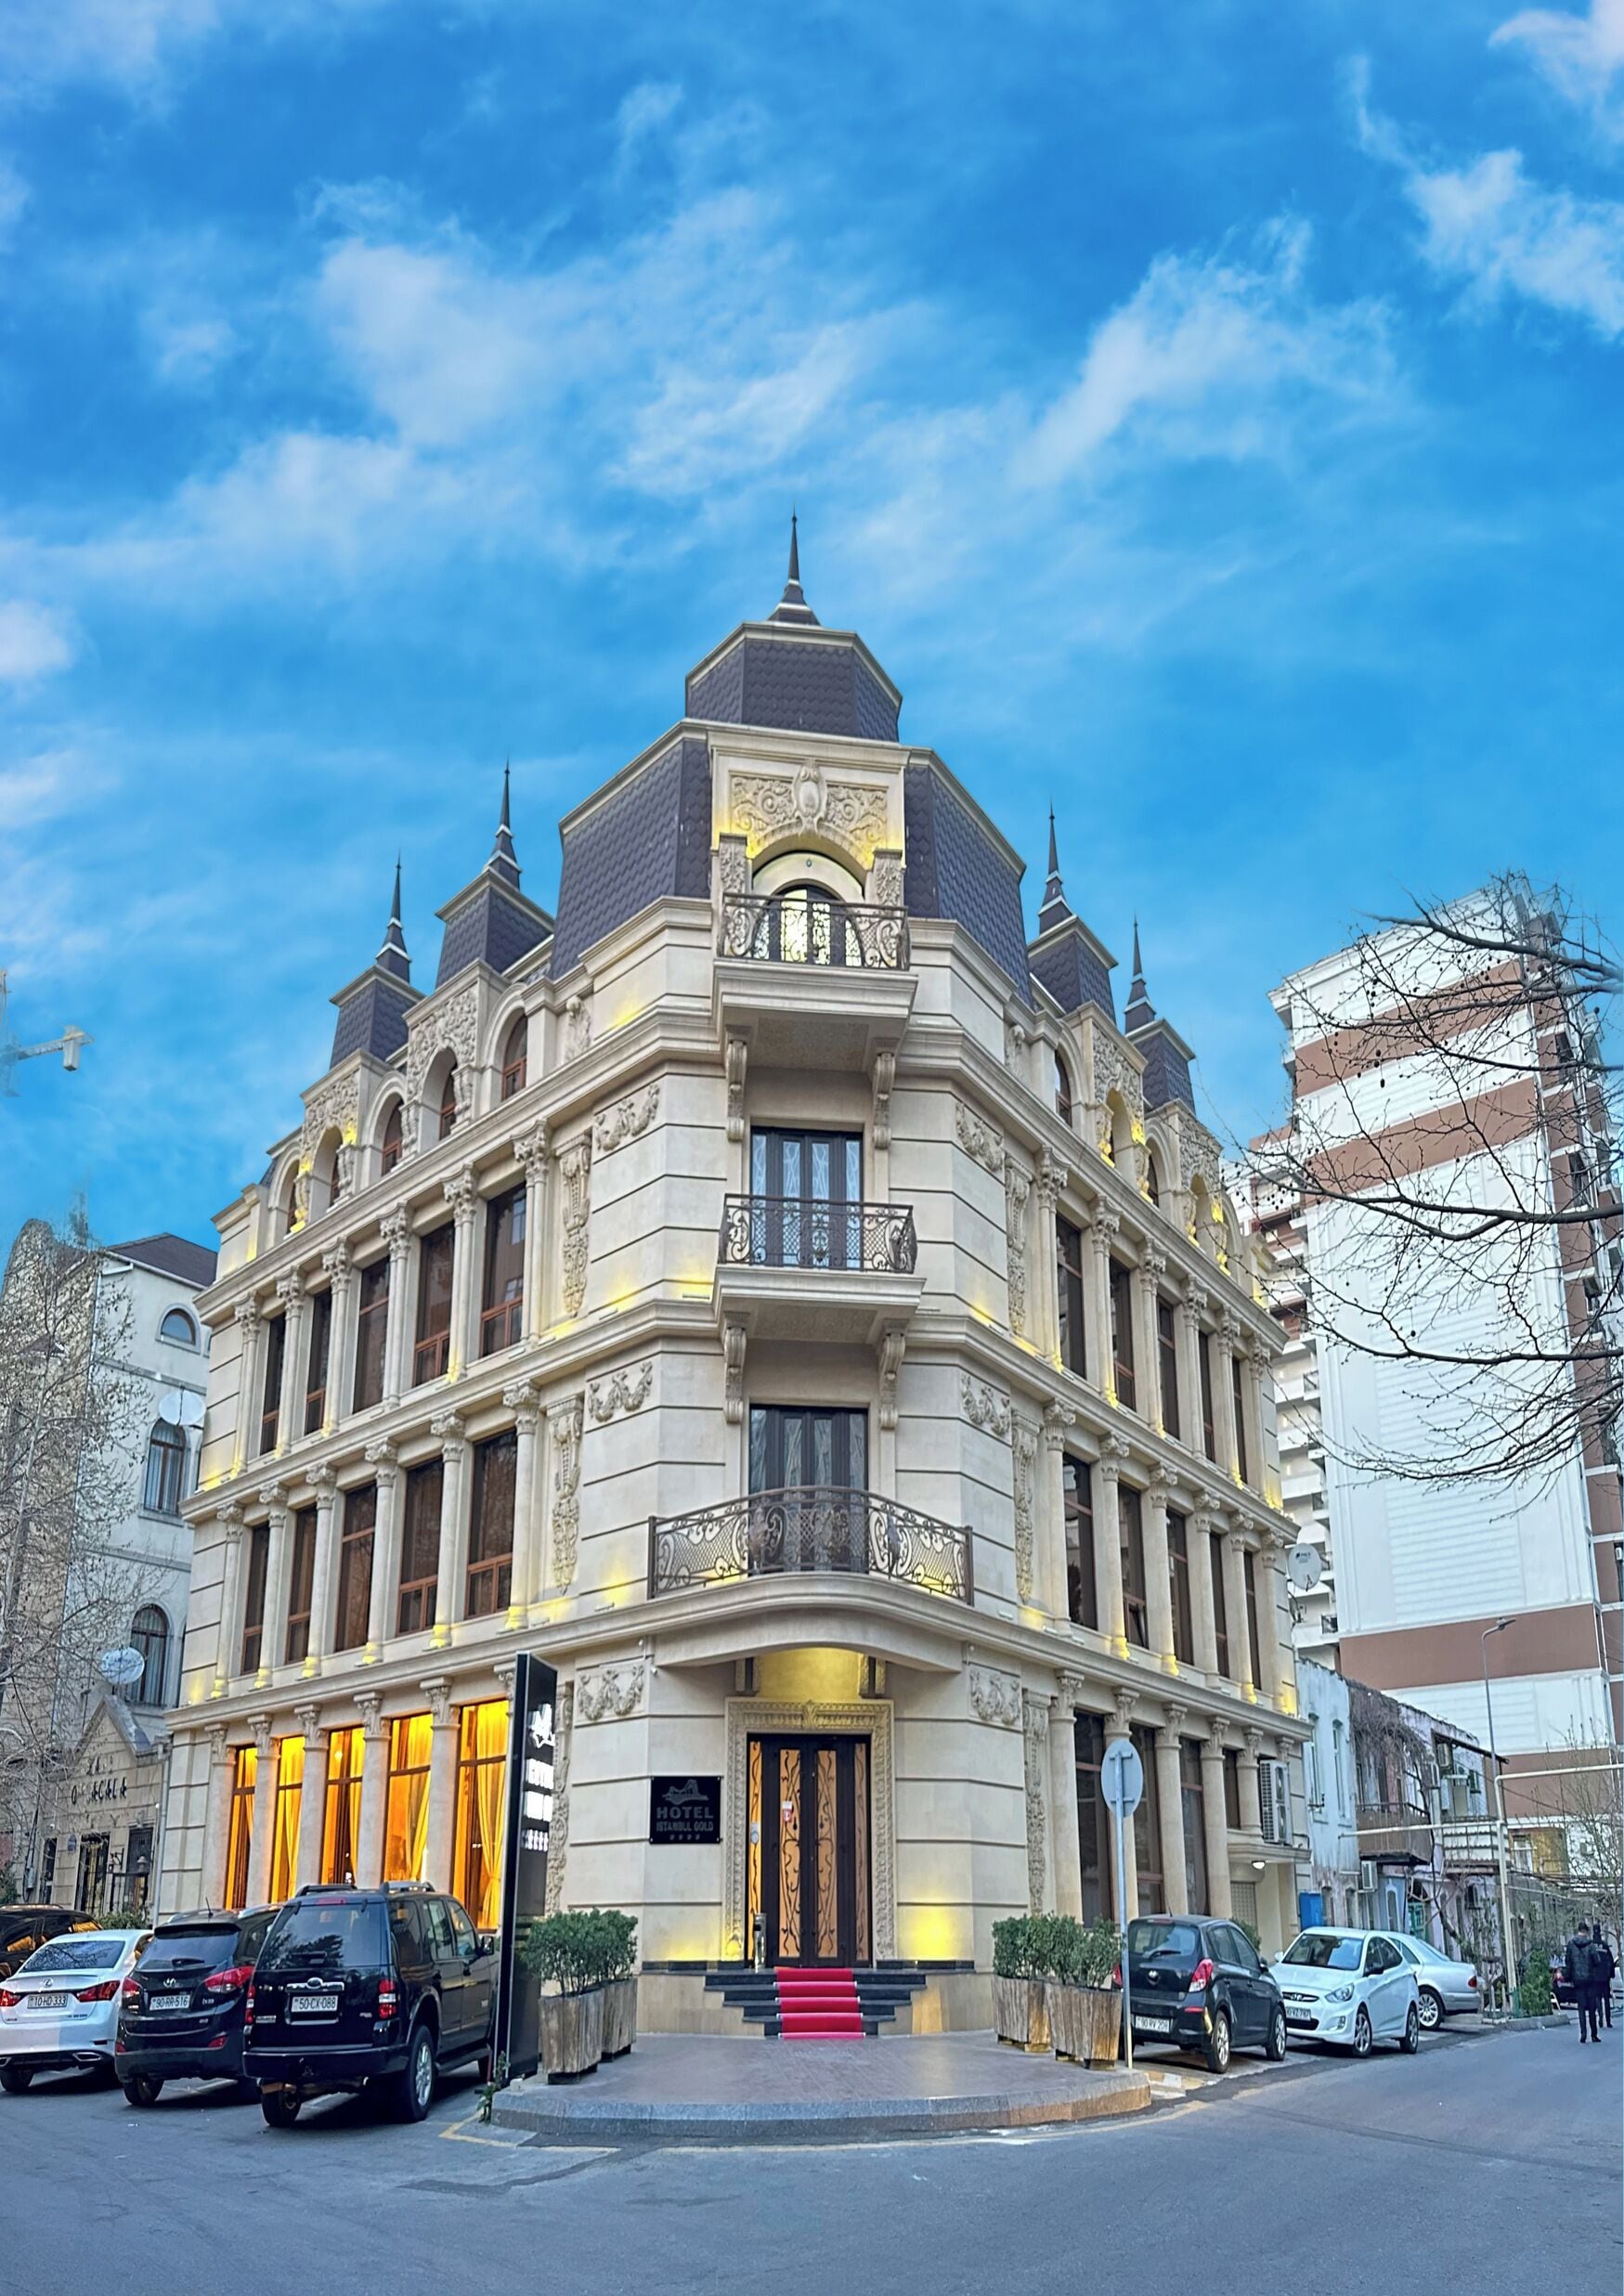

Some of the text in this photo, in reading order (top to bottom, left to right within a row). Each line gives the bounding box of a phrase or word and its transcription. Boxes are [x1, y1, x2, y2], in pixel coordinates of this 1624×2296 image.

[656, 1806, 713, 1819] HOTEL
[694, 1821, 714, 1832] GOLD
[299, 1997, 336, 2010] 50-CX-088
